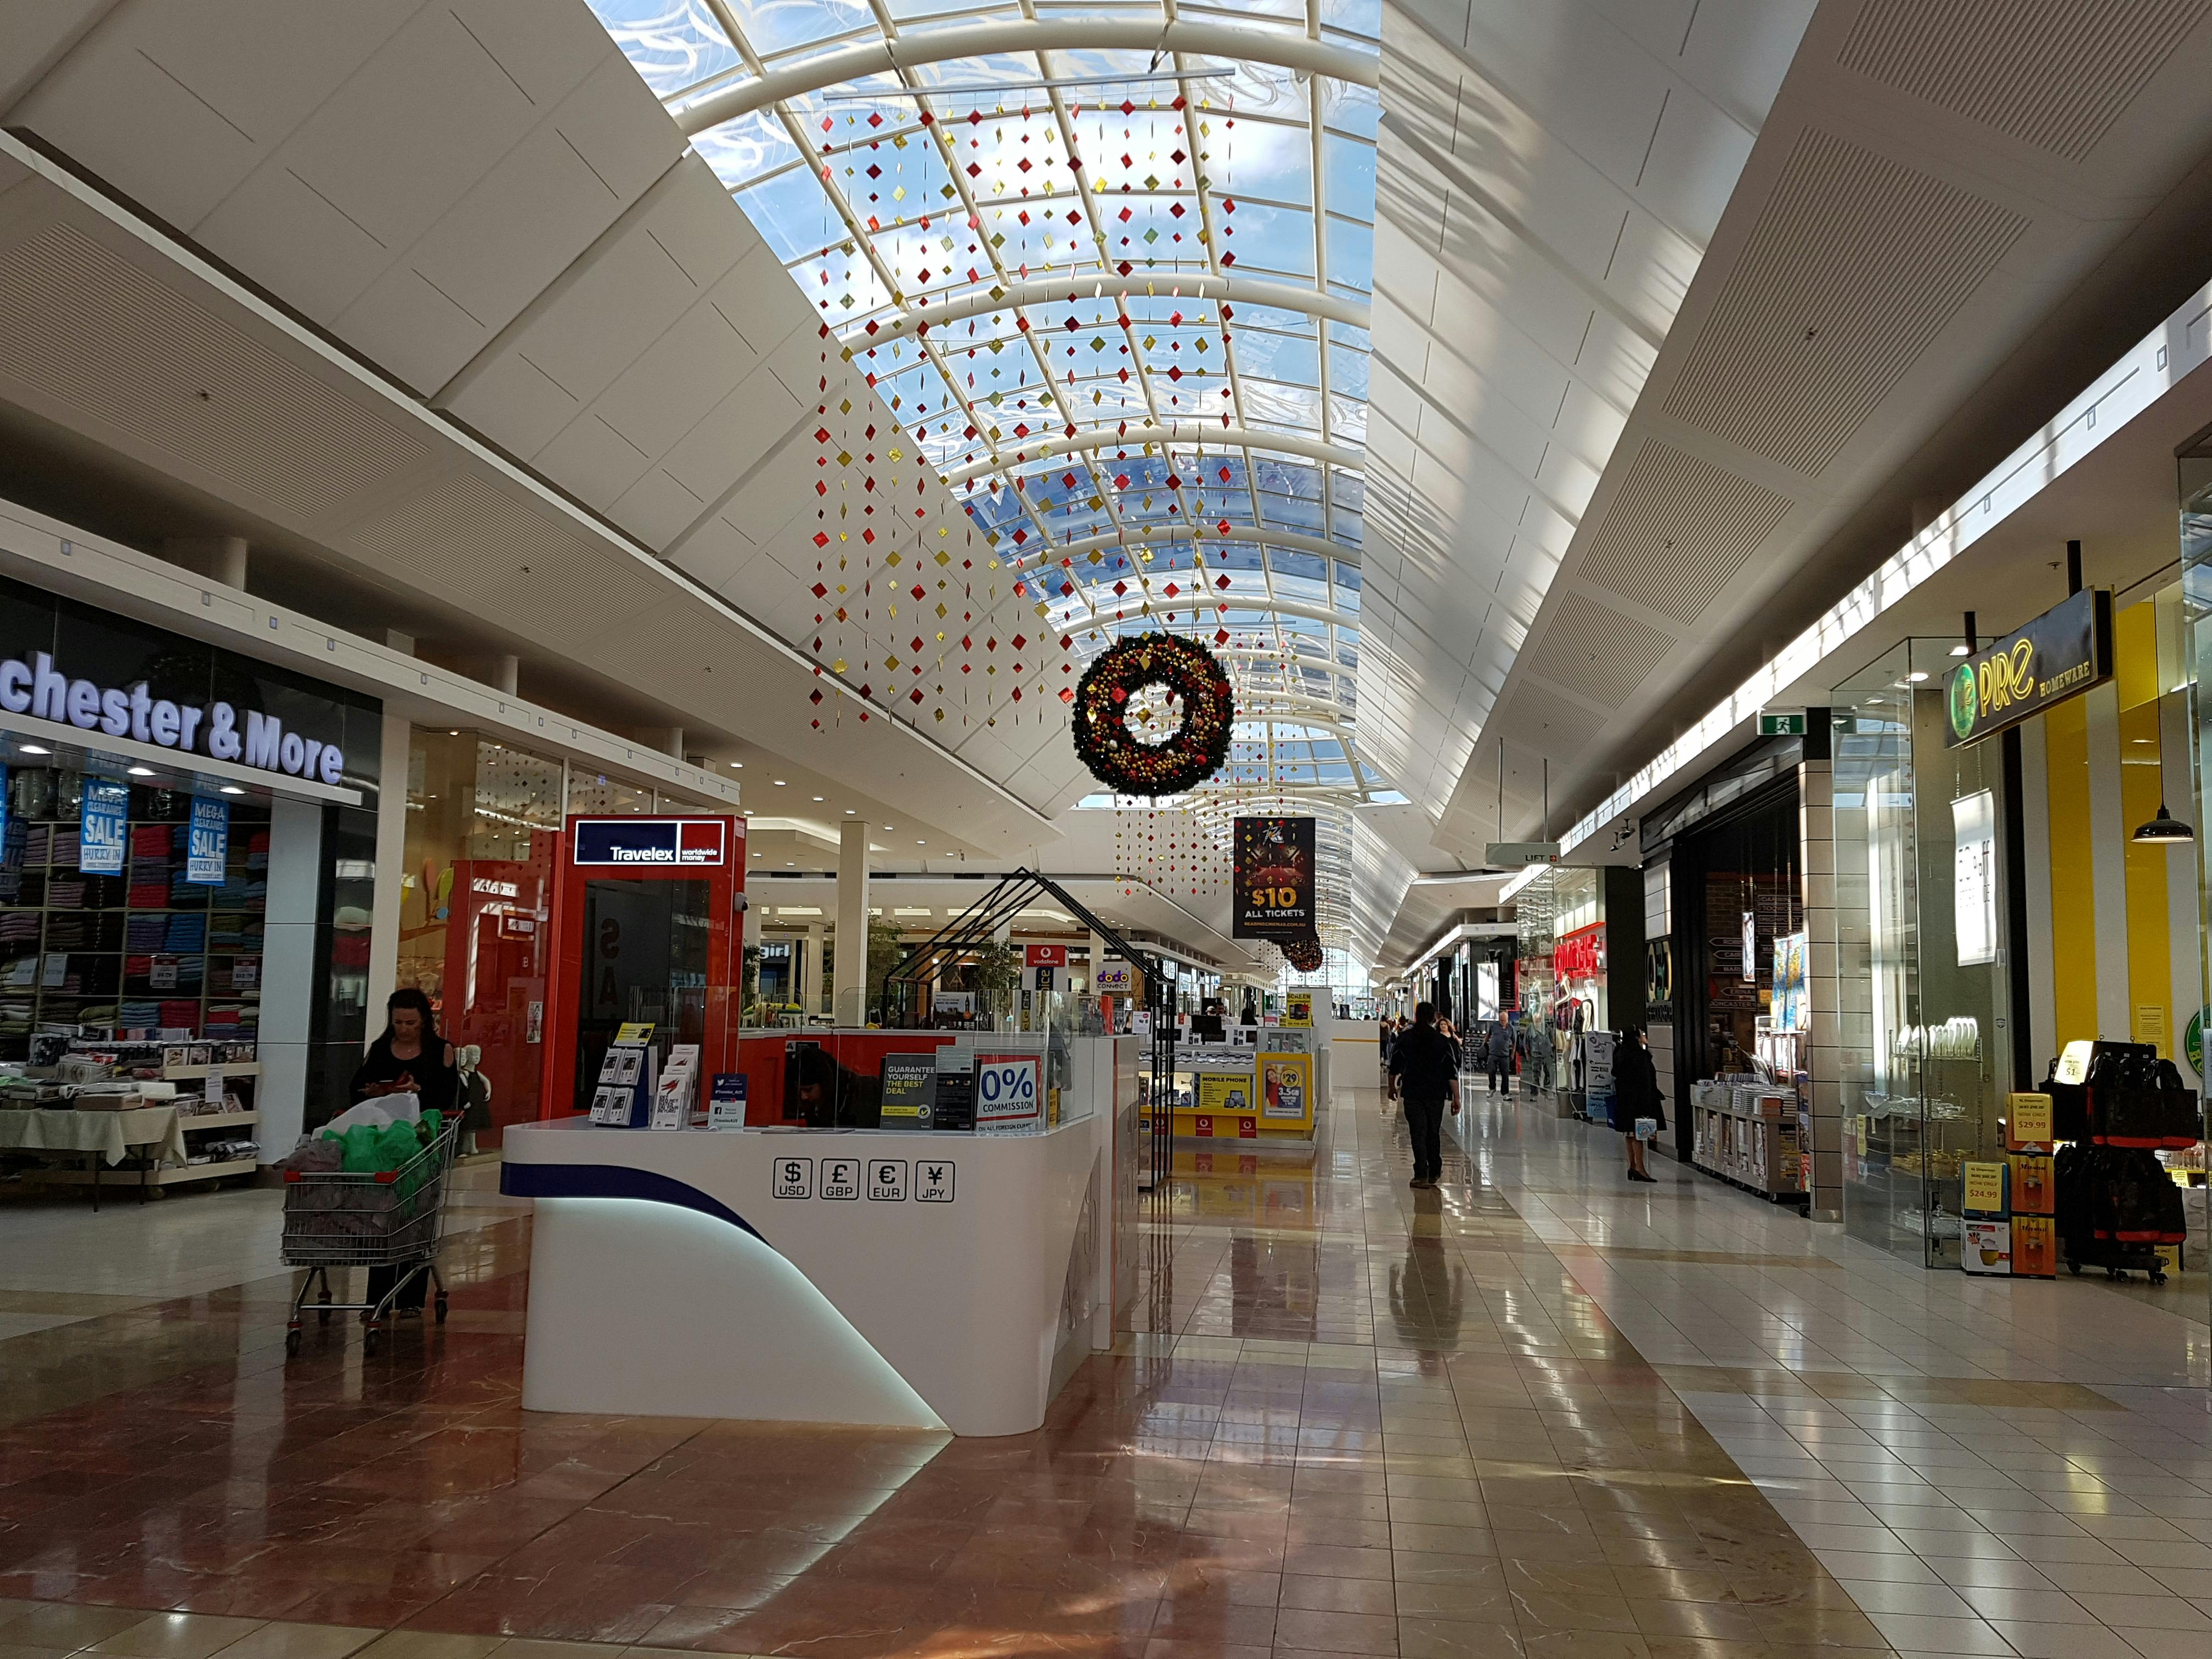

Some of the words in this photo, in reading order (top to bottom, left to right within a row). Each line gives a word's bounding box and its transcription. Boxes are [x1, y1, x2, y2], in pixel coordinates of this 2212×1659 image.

[2039, 661, 2090, 698] HOMEWARE
[0, 650, 203, 751] chester
[208, 702, 243, 761] &
[245, 709, 345, 785] More
[87, 785, 126, 804] MEGA
[195, 802, 225, 820] MEGA
[84, 814, 124, 847] SALE
[191, 830, 226, 858] SALE
[83, 848, 110, 861] HURRY
[112, 850, 121, 860] IN
[610, 847, 674, 861] Travelex
[189, 860, 212, 872] HURRY
[214, 861, 222, 871] IN
[1252, 887, 1296, 908] $10
[1245, 910, 1263, 918] ALL
[759, 944, 789, 959] girl
[1097, 970, 1128, 983] dodo
[981, 1068, 1033, 1101] 0%
[1283, 1074, 1297, 1082] $29
[1278, 1087, 1300, 1096] 3.5GB
[983, 1101, 1034, 1112] COMMISSION
[785, 1162, 801, 1184] $
[832, 1164, 848, 1183] £
[879, 1165, 896, 1184] €
[928, 1166, 943, 1185] ¥
[779, 1186, 805, 1196] USD
[826, 1186, 853, 1197] GBP
[873, 1187, 900, 1198] EUR
[922, 1189, 945, 1199] JPY
[1970, 1189, 1997, 1198] $24.99
